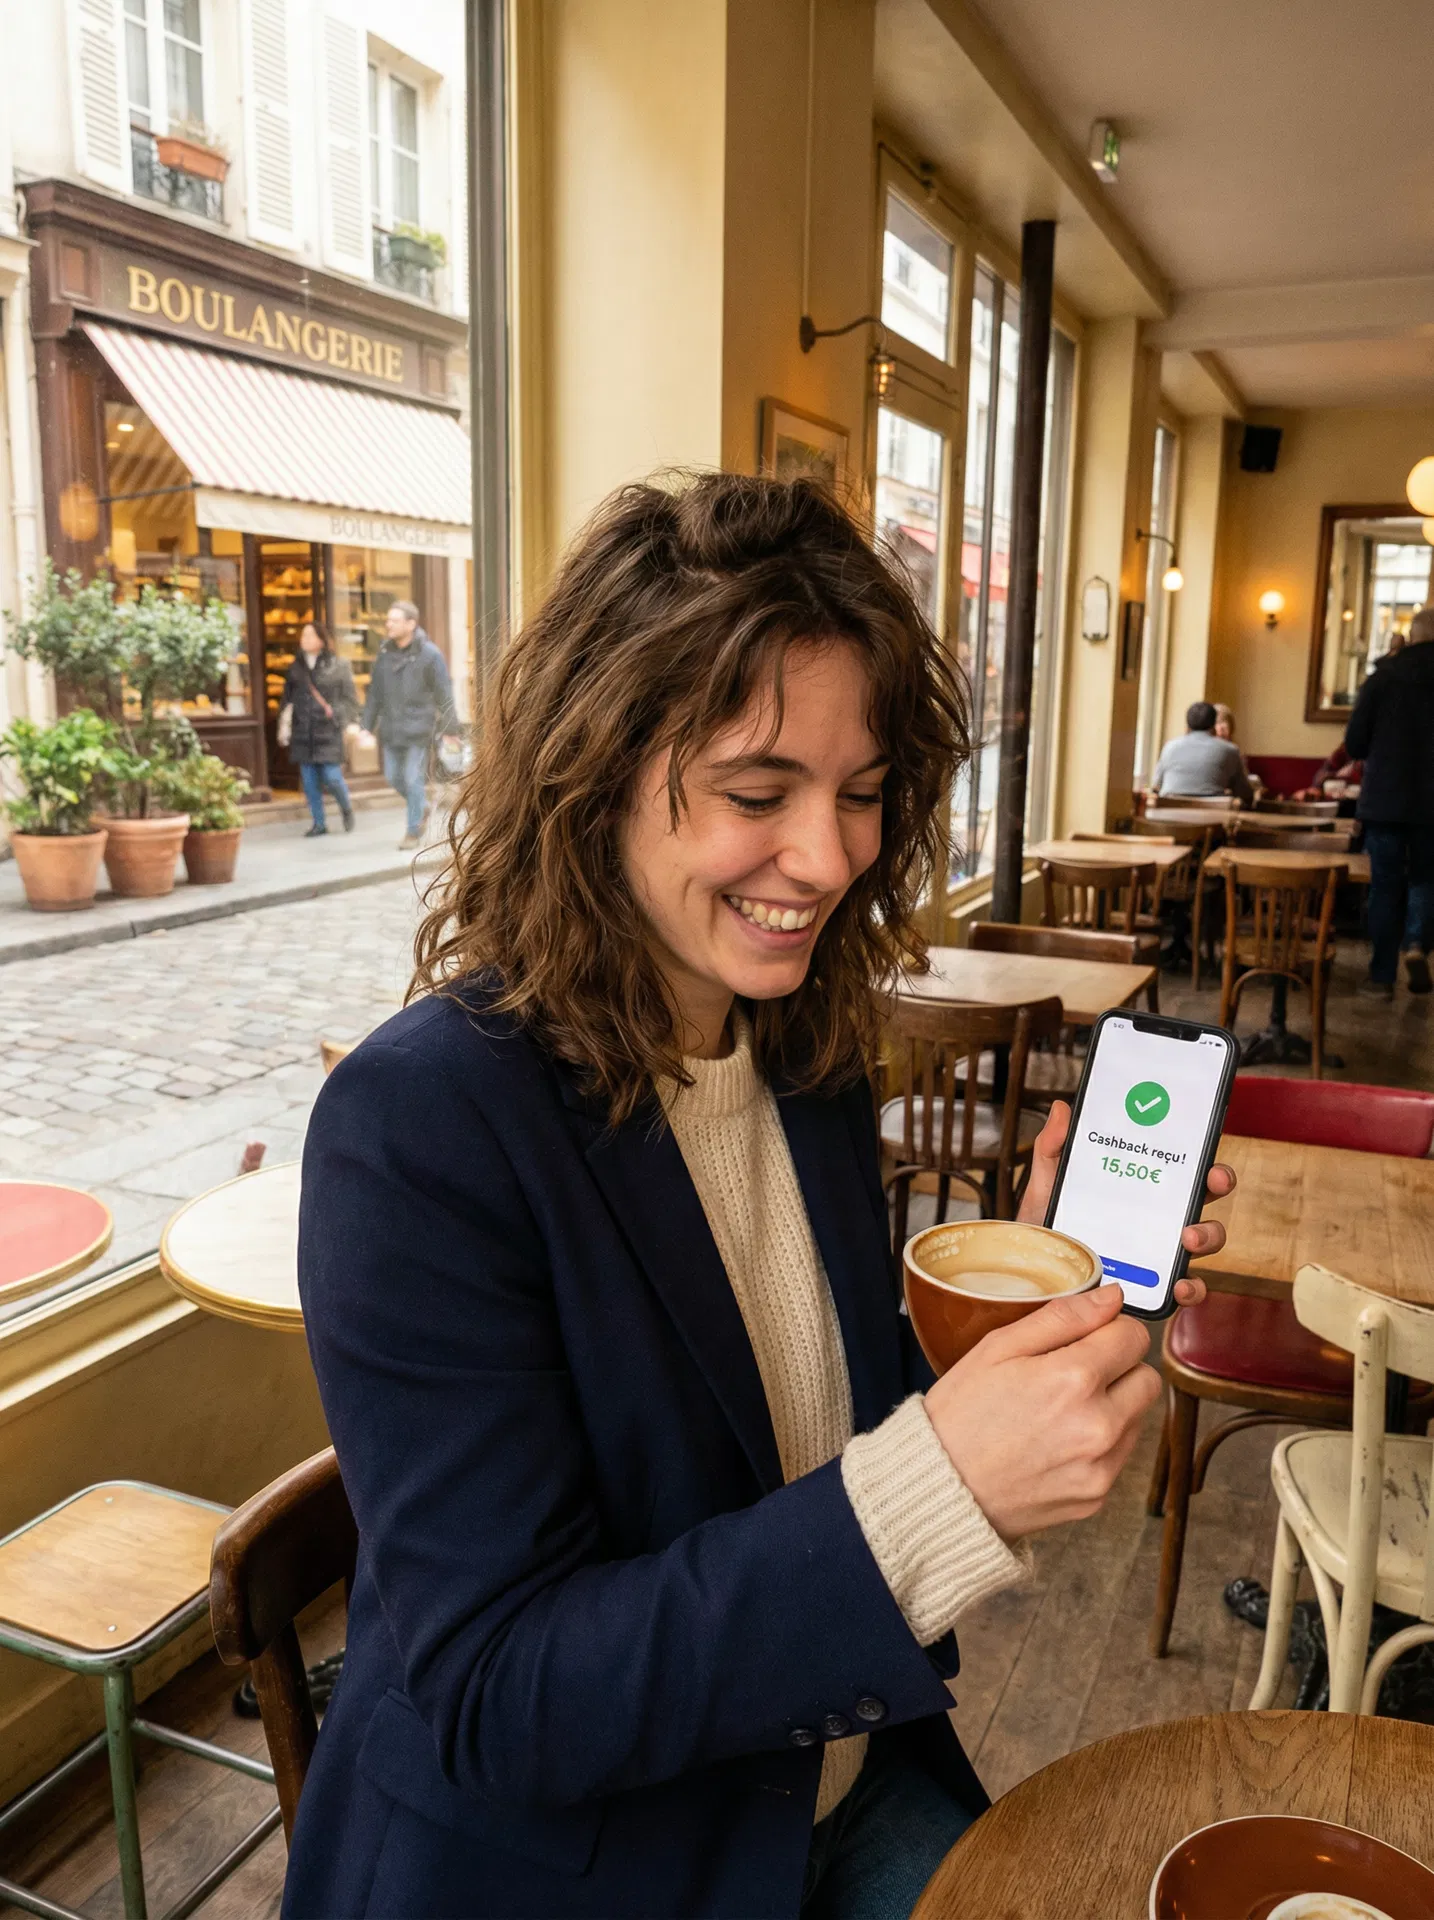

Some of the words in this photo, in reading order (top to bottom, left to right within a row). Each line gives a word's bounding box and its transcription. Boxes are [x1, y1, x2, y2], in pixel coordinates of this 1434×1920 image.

[127, 266, 404, 382] BOULANGERIE
[330, 515, 450, 548] BOULANGERIE
[1088, 1131, 1148, 1155] Cashback
[1101, 1156, 1162, 1183] 15,50€
